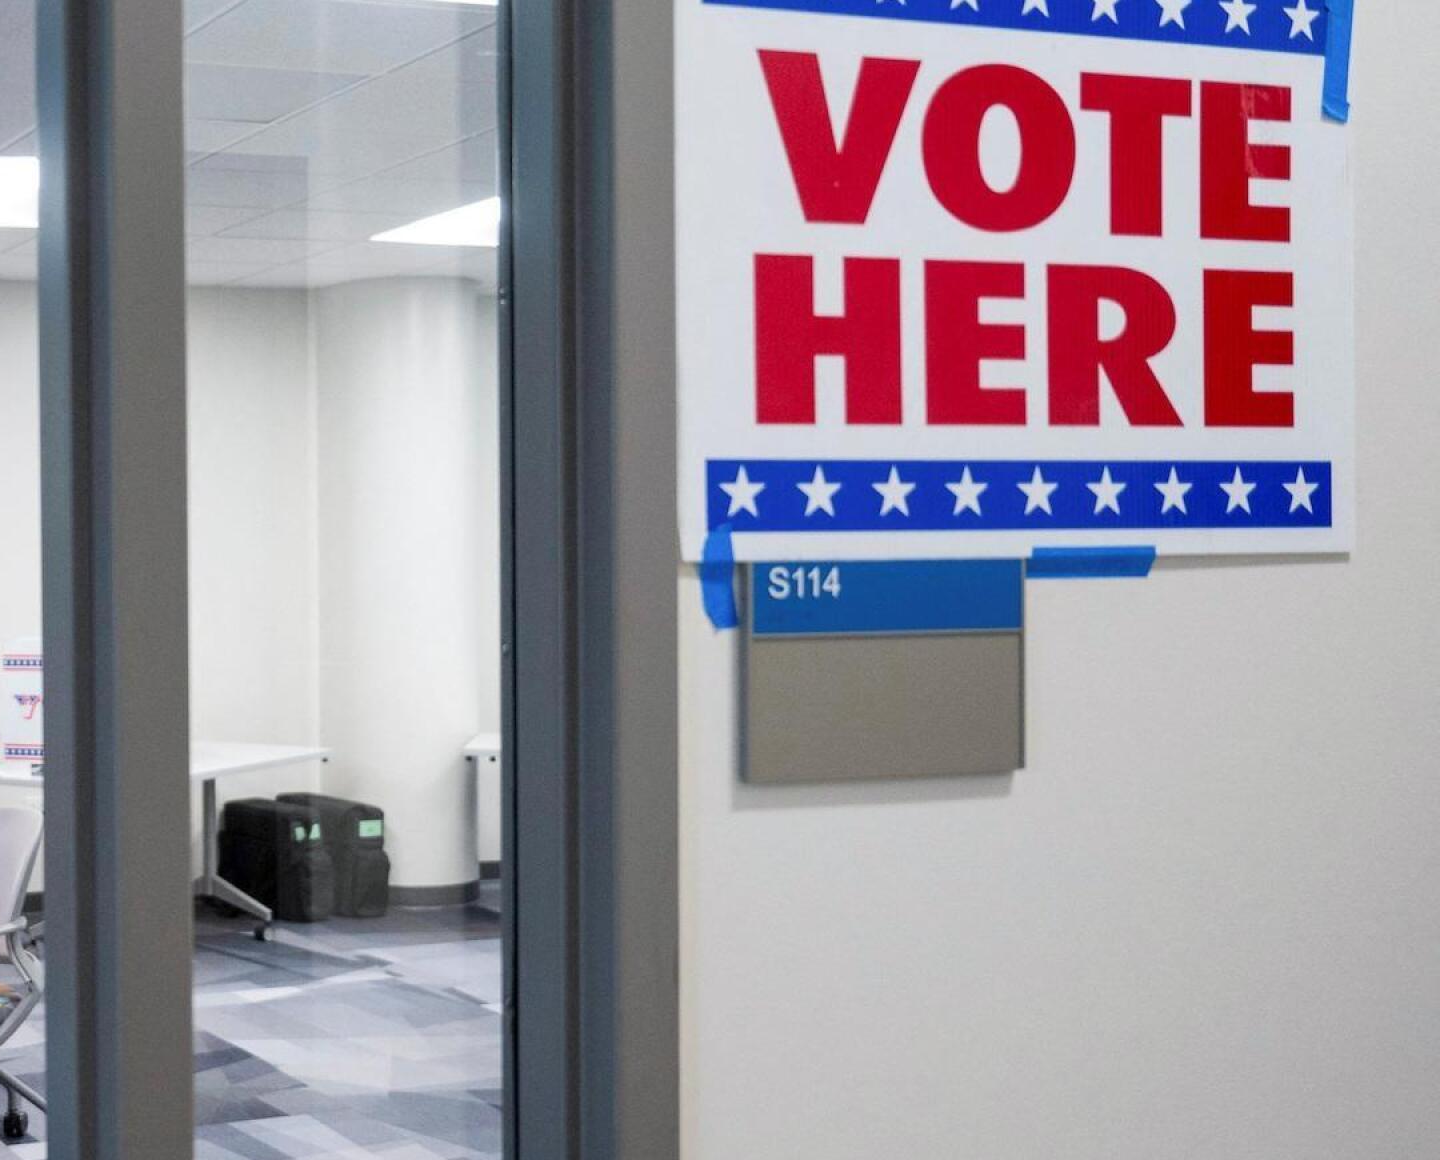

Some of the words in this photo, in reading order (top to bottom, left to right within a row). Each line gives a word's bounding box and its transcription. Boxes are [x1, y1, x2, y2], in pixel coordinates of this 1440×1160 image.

[757, 48, 1291, 242] VOTE
[754, 253, 1294, 427] HERE
[767, 565, 841, 600] S114
